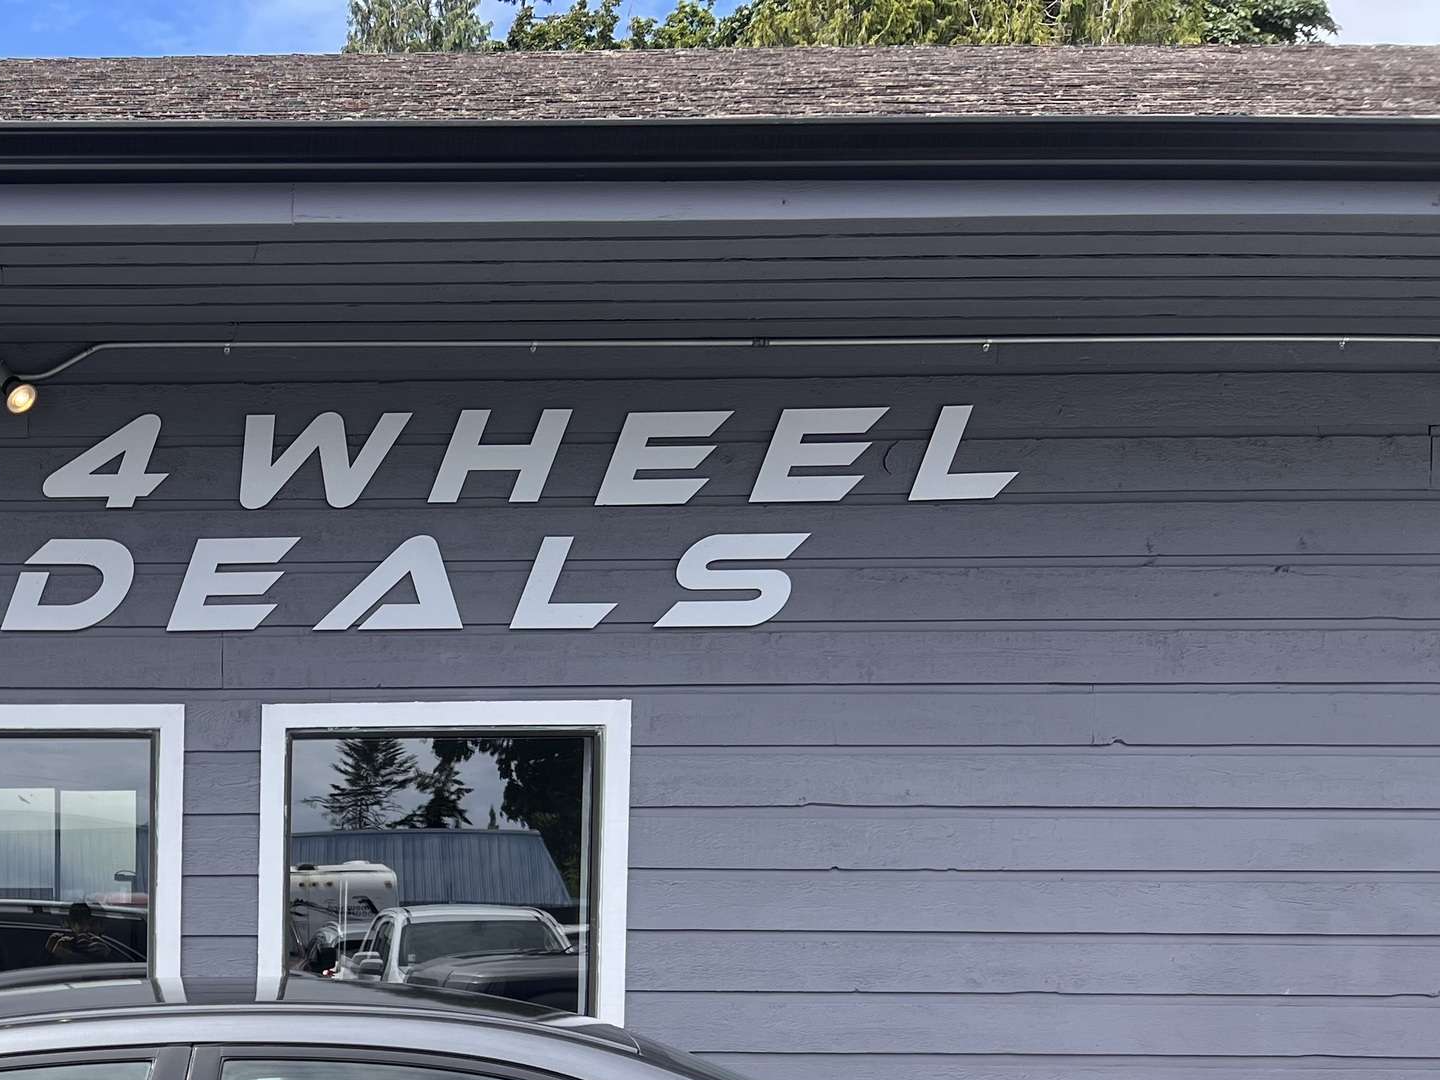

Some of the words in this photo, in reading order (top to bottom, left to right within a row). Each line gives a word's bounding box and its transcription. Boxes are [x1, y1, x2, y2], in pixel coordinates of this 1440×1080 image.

[43, 413, 170, 508] 4
[240, 405, 1019, 509] WHEEL
[0, 533, 811, 631] DEALS
